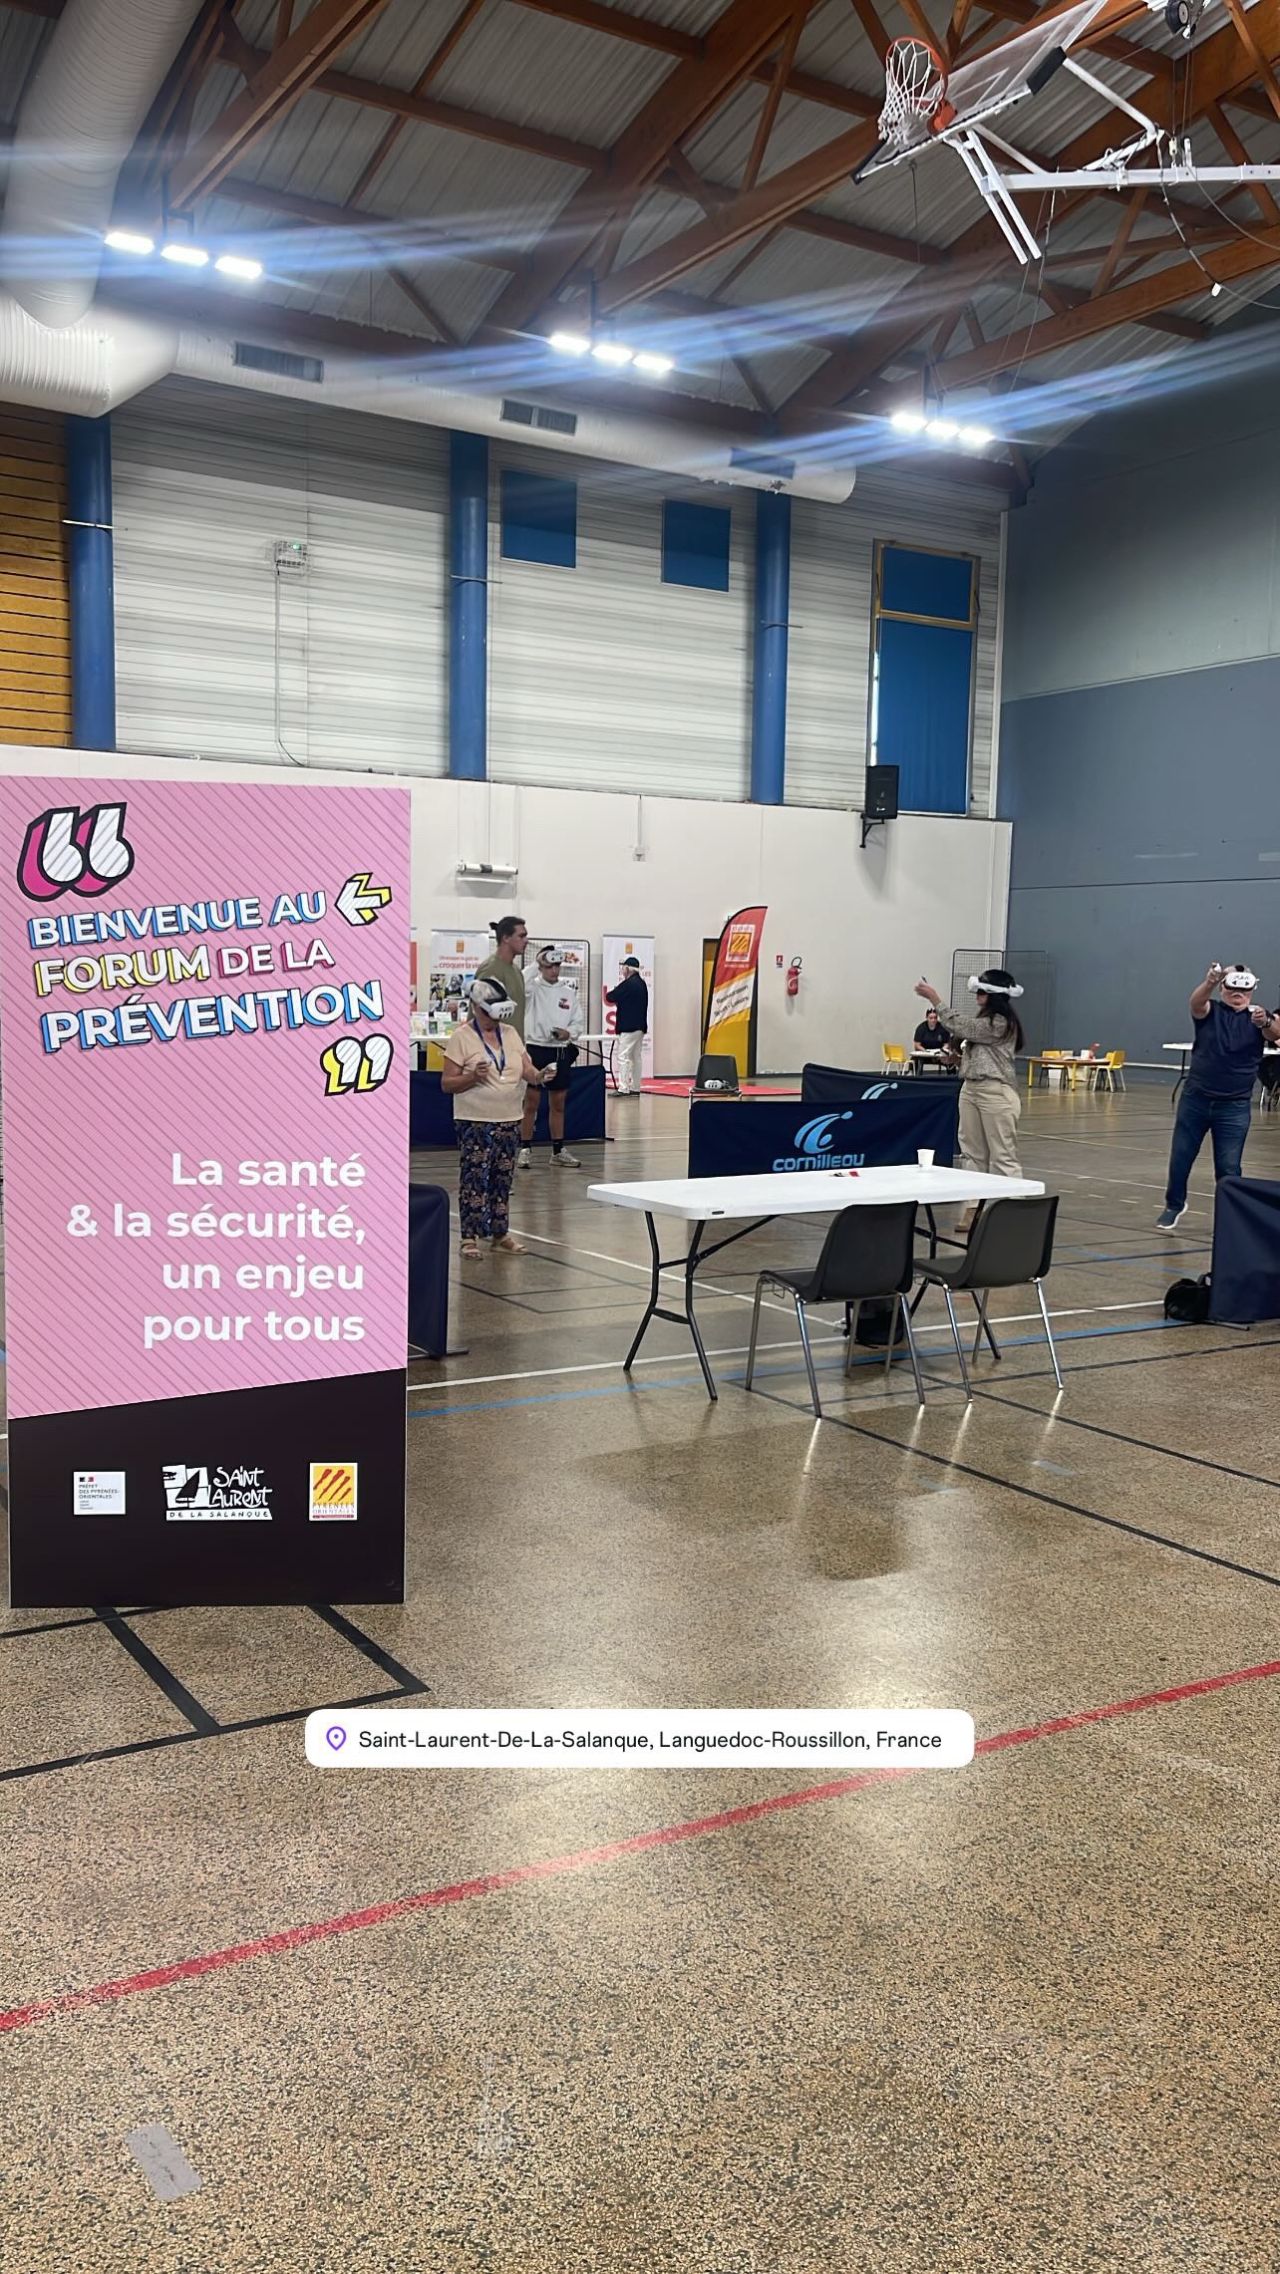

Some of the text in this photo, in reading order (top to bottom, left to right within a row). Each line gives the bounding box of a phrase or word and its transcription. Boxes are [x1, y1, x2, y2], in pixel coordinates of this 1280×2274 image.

[28, 891, 327, 949] BIENVENUE AU
[34, 938, 335, 996] FORUM DE LA
[41, 980, 384, 1053] PRÉVENTION
[172, 1152, 366, 1187] La santé
[67, 1202, 366, 1245] & la sécurité,
[163, 1256, 364, 1298] un enjeu
[144, 1311, 366, 1349] pour tous
